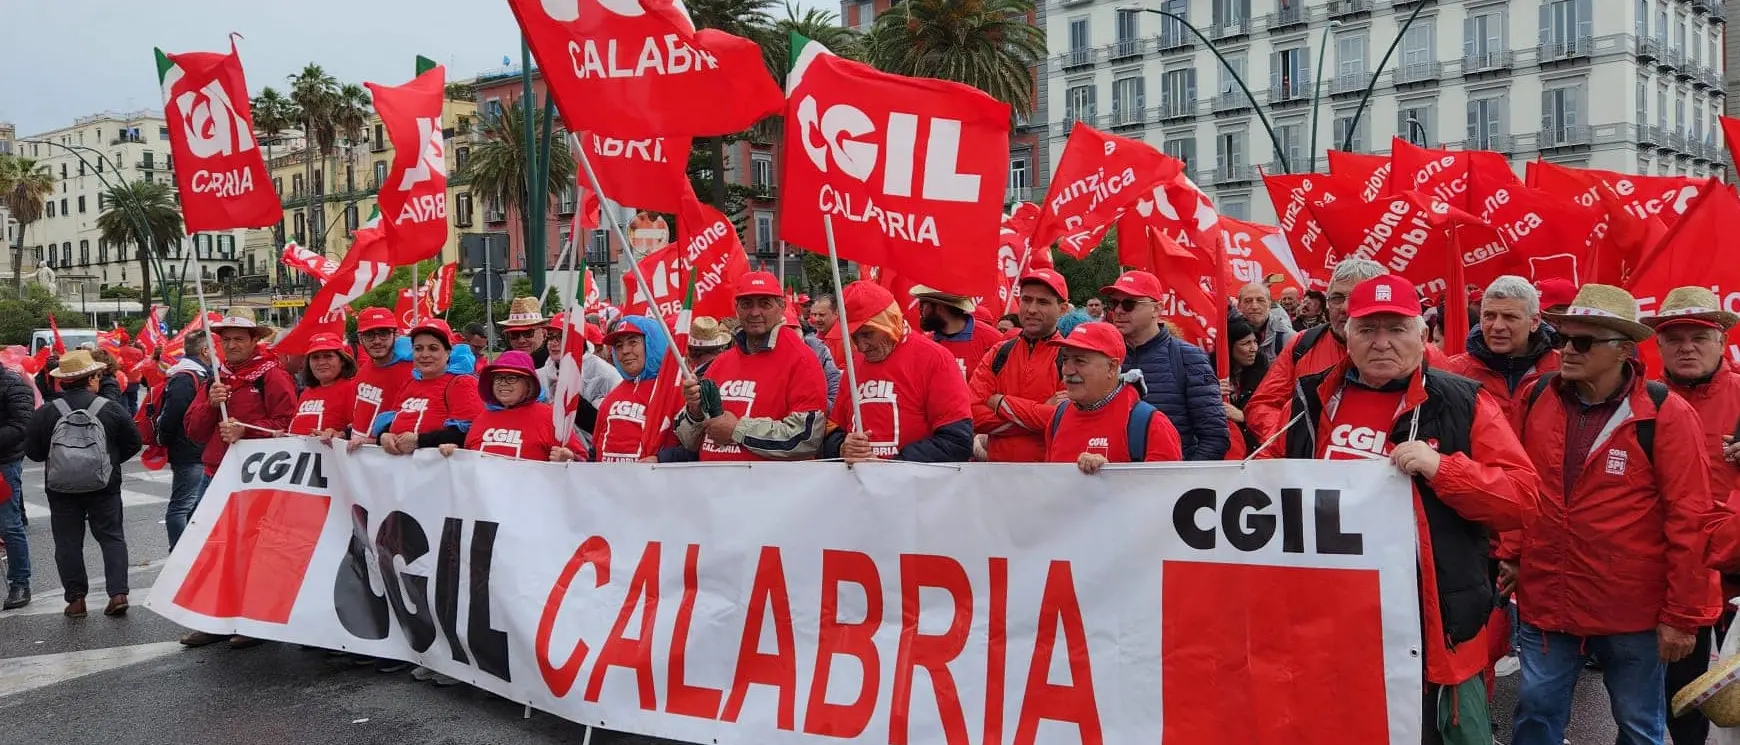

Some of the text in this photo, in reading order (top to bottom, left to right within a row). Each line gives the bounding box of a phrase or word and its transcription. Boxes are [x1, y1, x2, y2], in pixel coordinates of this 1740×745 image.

[797, 94, 982, 203] CGIL
[1463, 241, 1505, 262] CGIL
[358, 382, 383, 402] CGIL
[720, 380, 756, 398] CGIL
[299, 399, 325, 412] CGIL
[401, 398, 429, 411] CGIL
[609, 401, 647, 420] CGIL
[483, 428, 523, 444] CGIL
[1088, 438, 1109, 447] CGIL
[1331, 424, 1389, 456] CGI
[241, 451, 328, 488] CGIL
[1172, 487, 1363, 555] CGIL
[334, 504, 512, 682] CGIL
[535, 535, 1104, 745] CALABRIA
